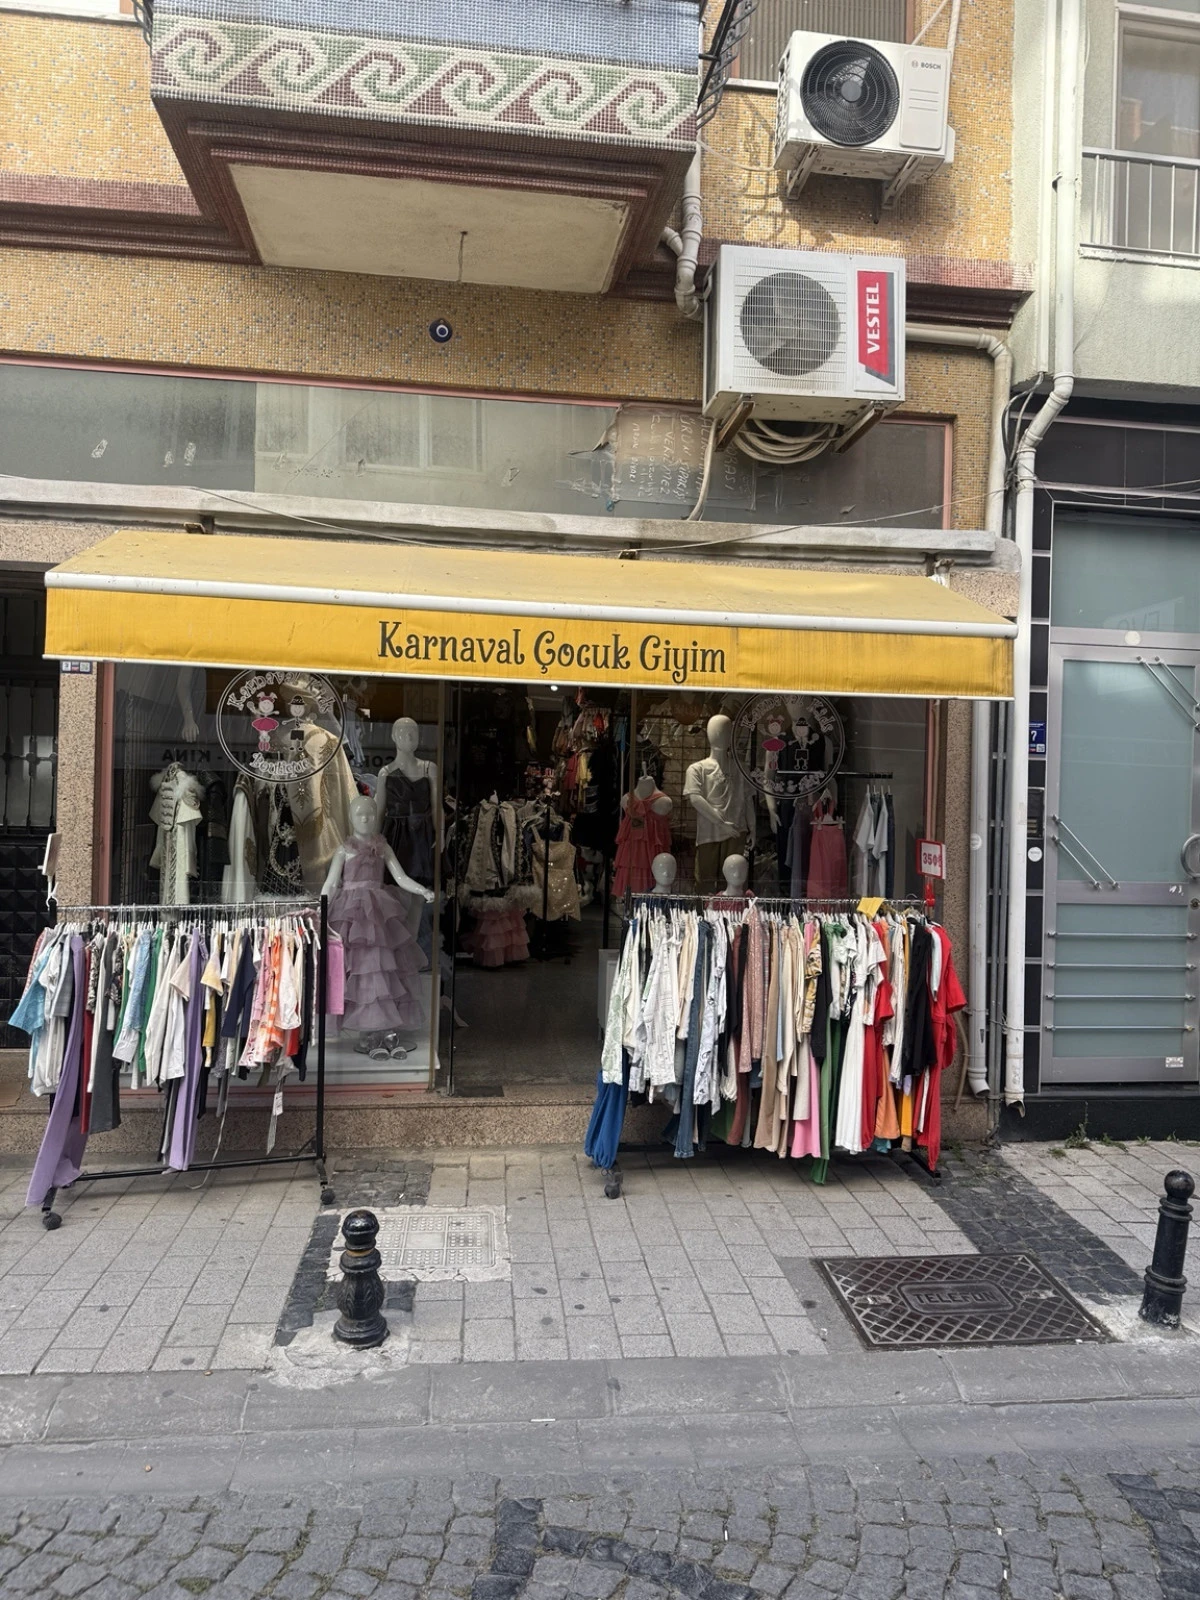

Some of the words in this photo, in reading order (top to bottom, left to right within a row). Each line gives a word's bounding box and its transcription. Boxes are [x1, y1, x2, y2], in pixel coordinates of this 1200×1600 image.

[920, 61, 942, 70] BOSCH
[866, 282, 881, 354] VESTEL
[378, 621, 525, 665] Karnaval
[534, 630, 631, 674] Çocuk
[640, 635, 726, 684] Giyim
[1031, 730, 1038, 742] 7
[249, 752, 312, 778] Boutique
